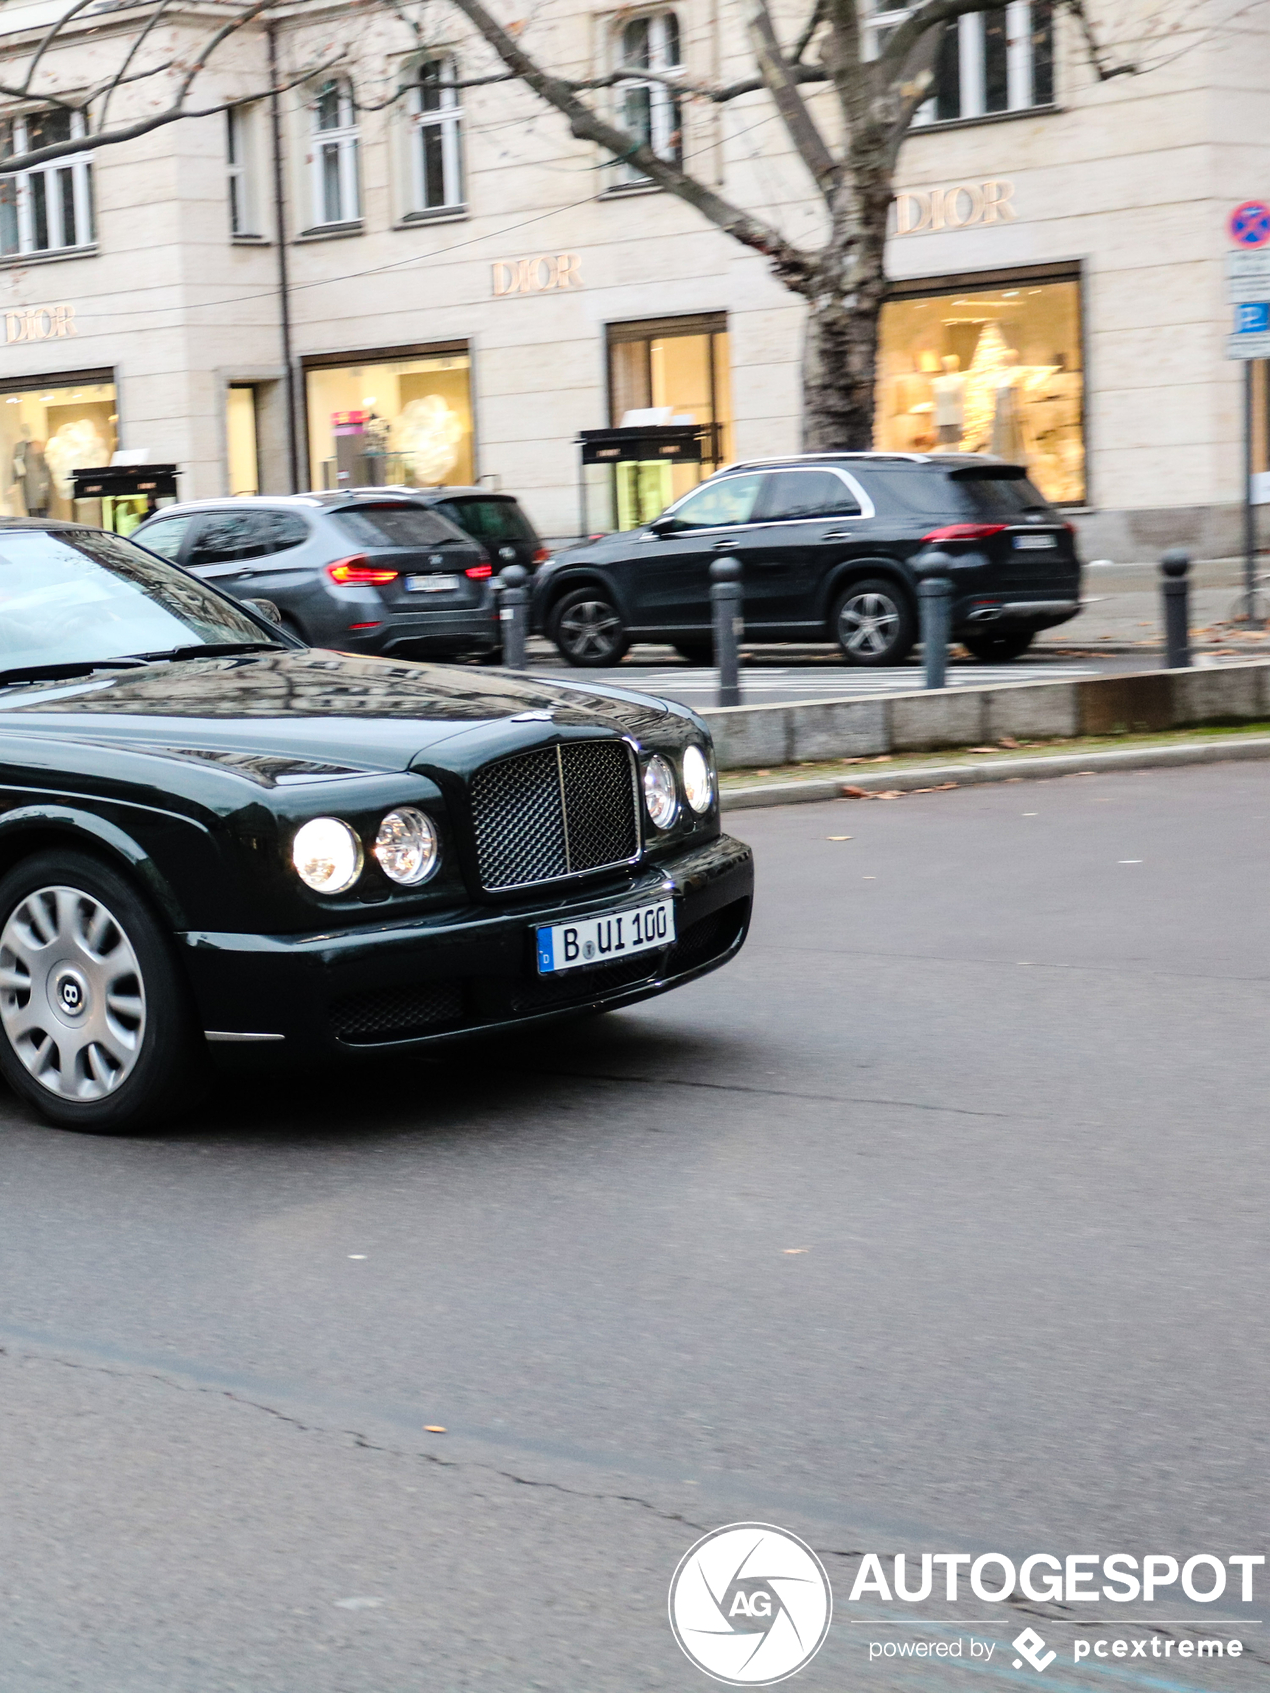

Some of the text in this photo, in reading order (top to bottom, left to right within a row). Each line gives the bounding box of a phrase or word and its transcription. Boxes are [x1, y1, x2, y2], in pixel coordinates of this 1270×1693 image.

[893, 180, 1019, 235] DIOR
[491, 252, 585, 297] DIOR
[4, 305, 78, 343] DIOR
[564, 928, 579, 962] B
[597, 917, 625, 953] UI
[632, 906, 667, 946] 100
[543, 954, 550, 964] D
